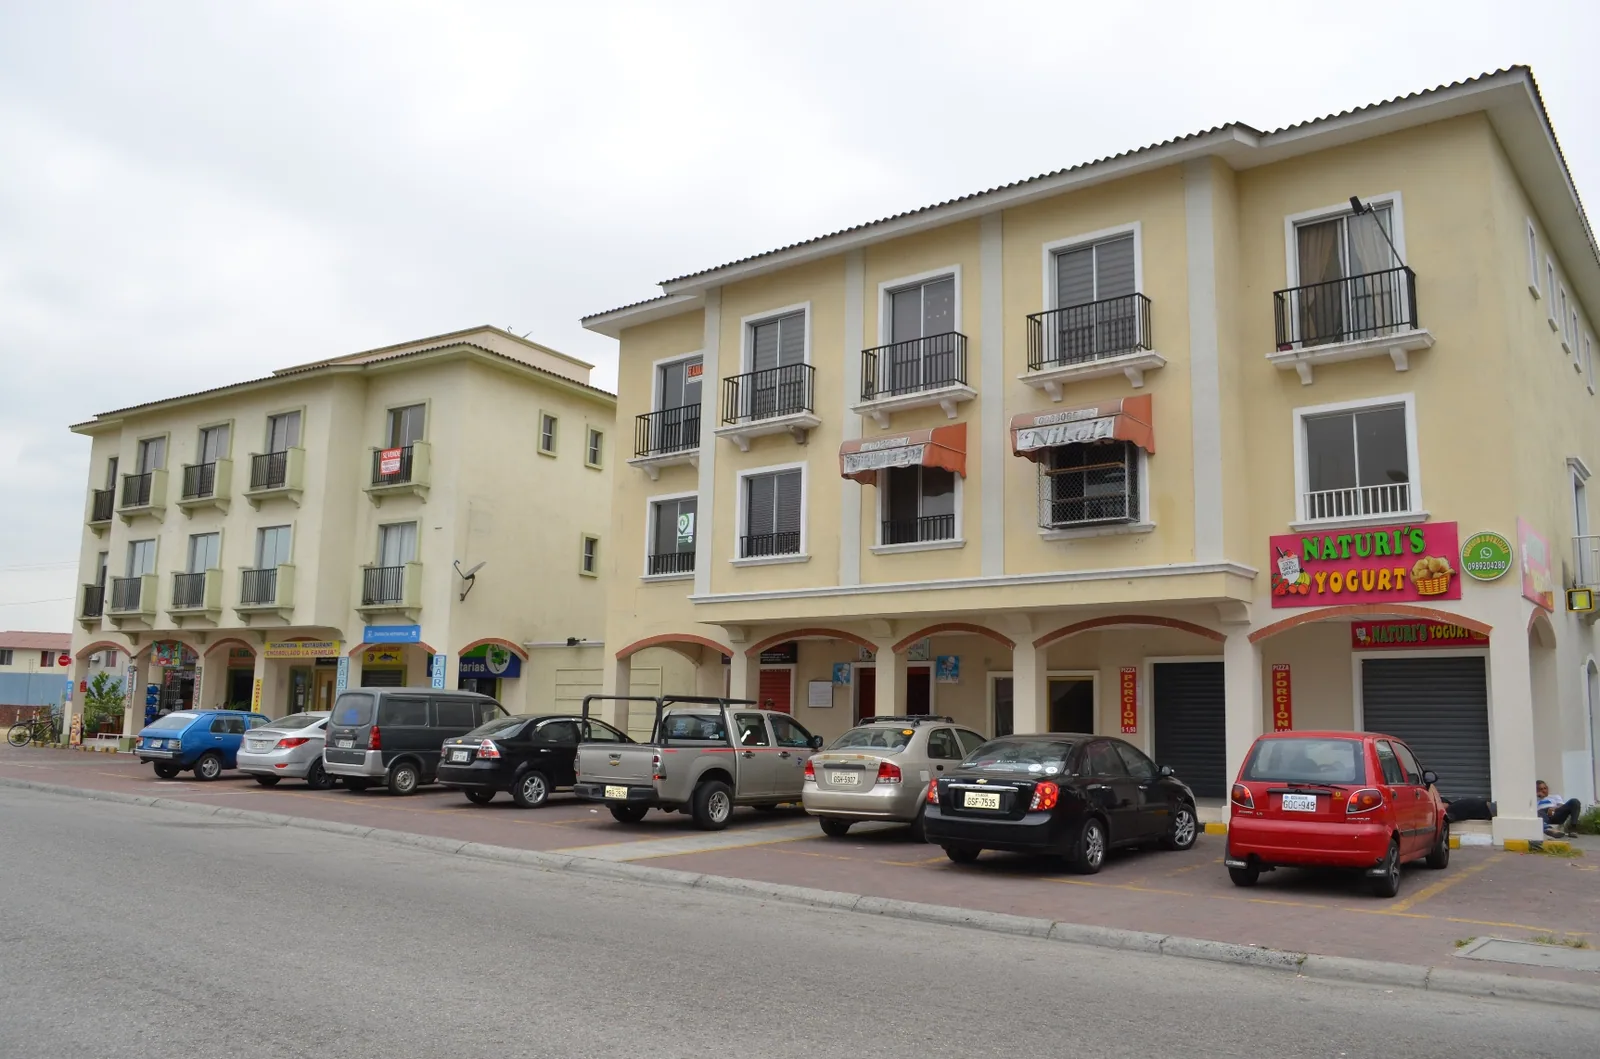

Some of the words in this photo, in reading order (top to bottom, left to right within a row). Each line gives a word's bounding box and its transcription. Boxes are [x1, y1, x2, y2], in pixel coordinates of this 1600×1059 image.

[1302, 525, 1425, 561] NATURI'S
[1314, 567, 1406, 594] YOGURT
[1372, 624, 1427, 643] NATURI'S
